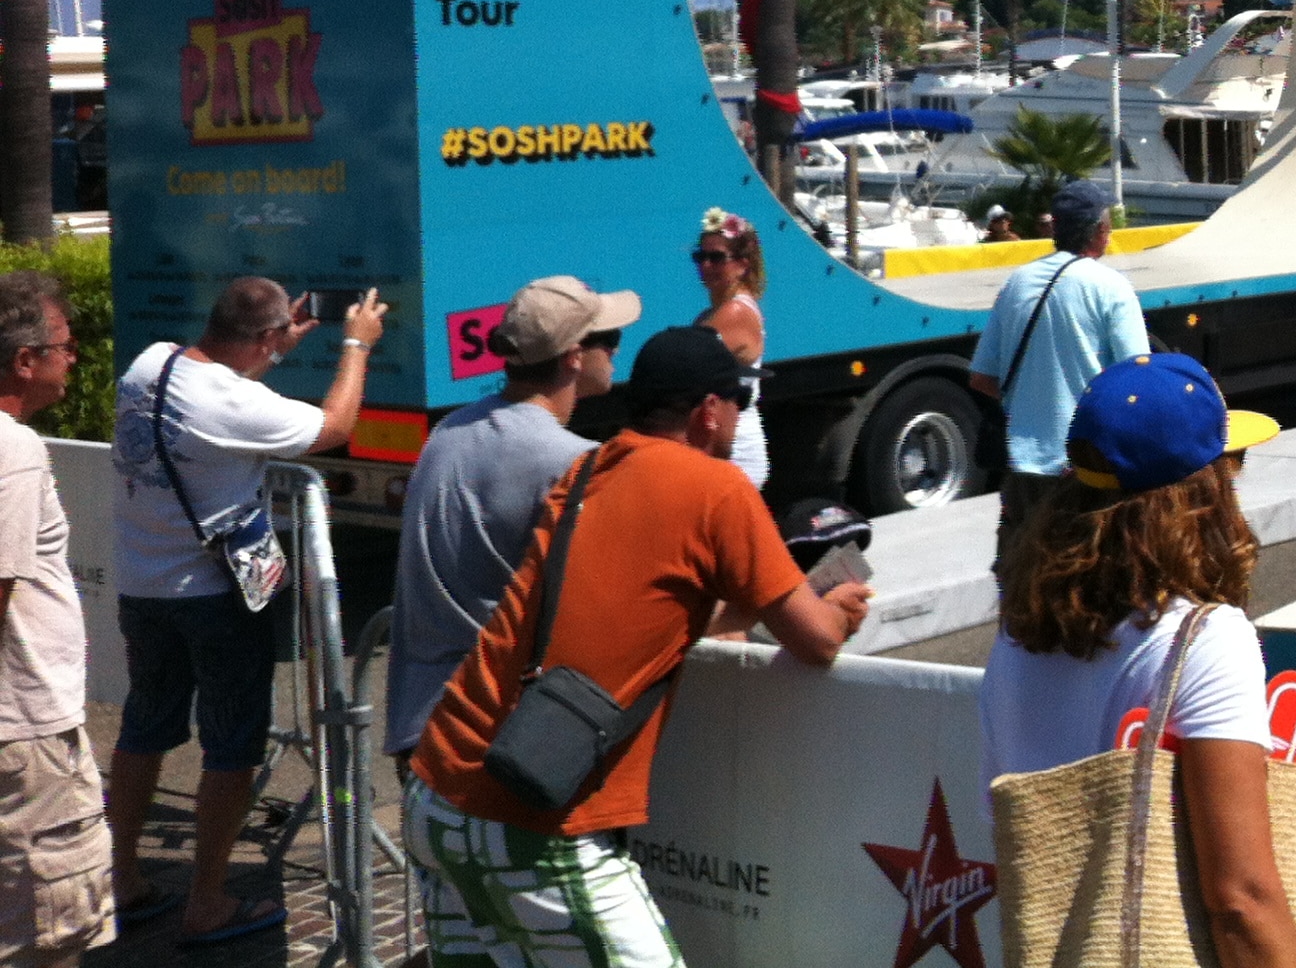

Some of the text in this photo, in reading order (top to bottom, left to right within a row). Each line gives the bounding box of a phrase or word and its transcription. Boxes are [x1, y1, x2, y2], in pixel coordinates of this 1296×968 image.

[180, 32, 324, 129] PARK
[167, 160, 346, 195] Come on board!
[441, 121, 654, 165] #SOSHPARK
[904, 834, 993, 949] Virgin
